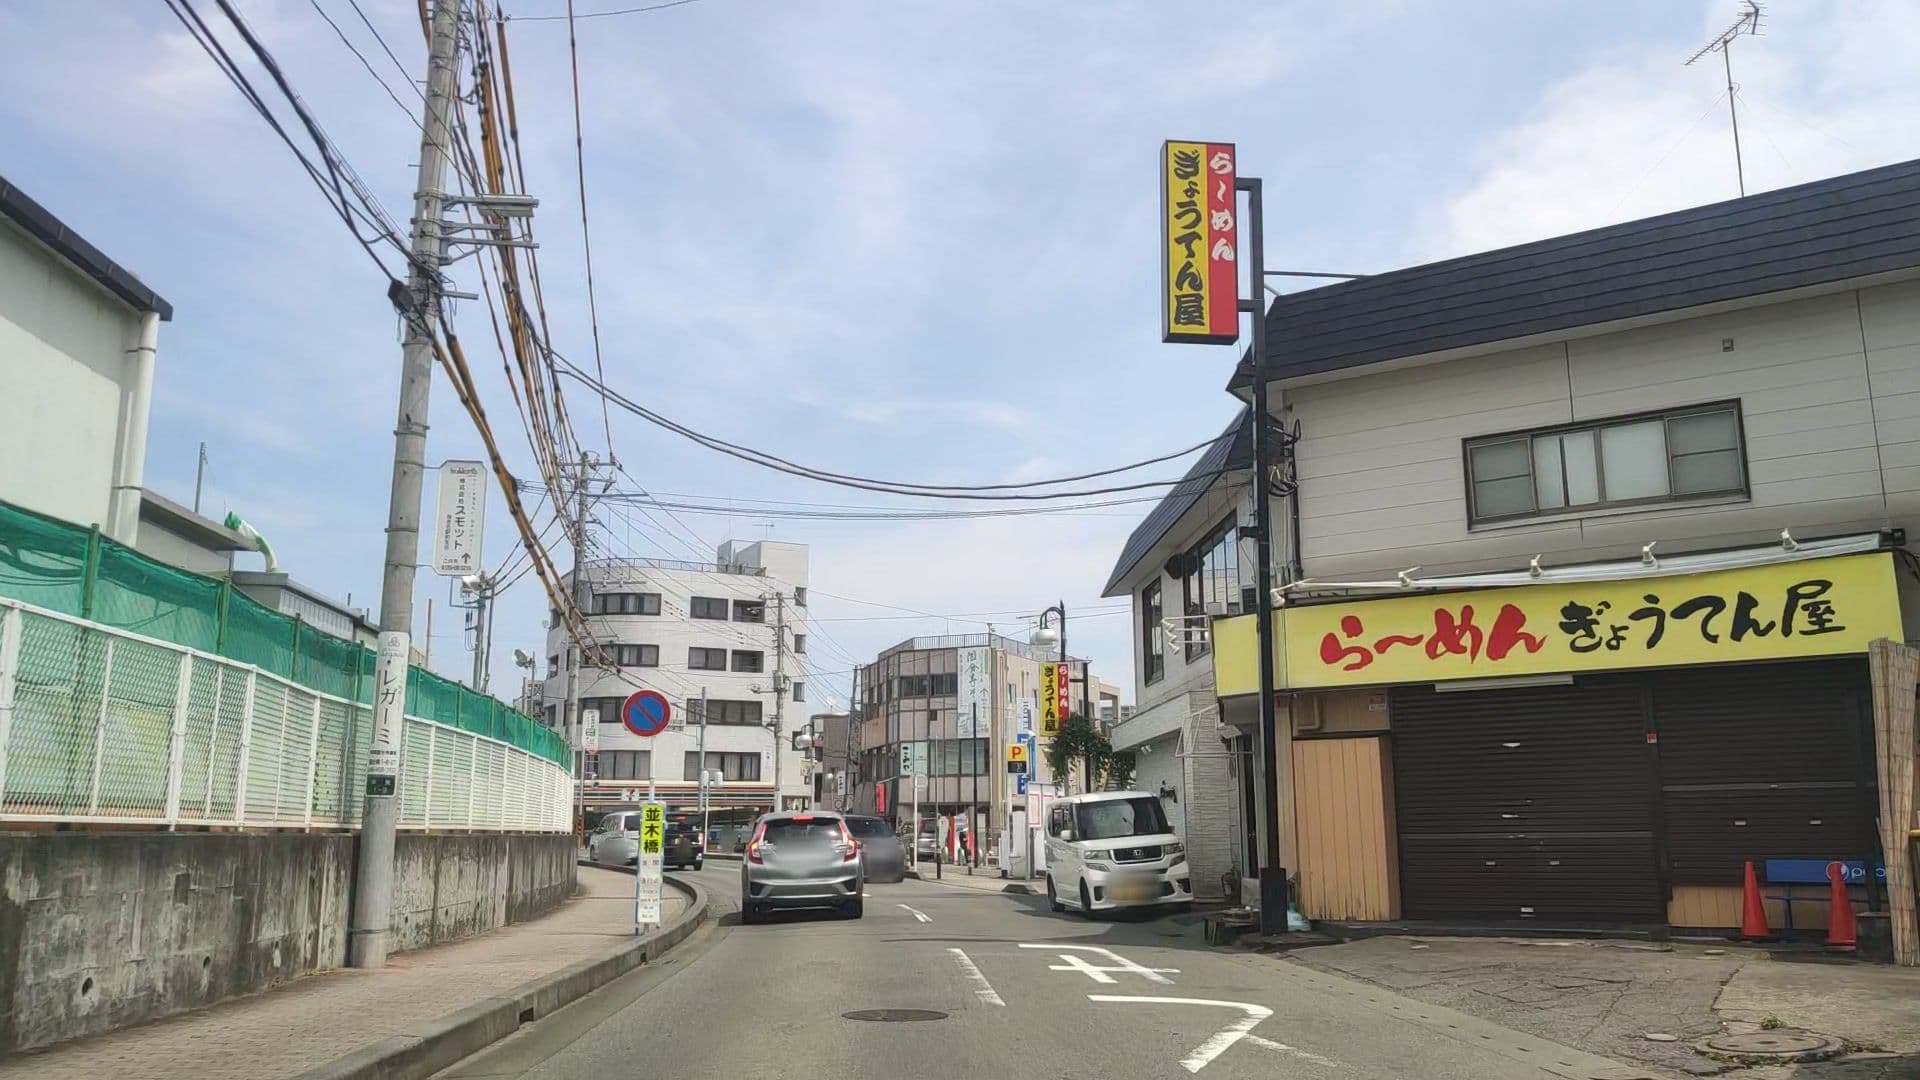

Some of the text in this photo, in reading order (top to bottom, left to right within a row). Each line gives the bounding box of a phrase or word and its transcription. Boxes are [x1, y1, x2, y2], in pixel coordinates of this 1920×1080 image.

[1174, 150, 1206, 327] ぎょうてん屋
[1558, 579, 1846, 653] ぎょうてん屋
[1045, 666, 1056, 731] ぎょうてん屋
[1012, 747, 1022, 759] P
[644, 807, 660, 853] 並木橋
